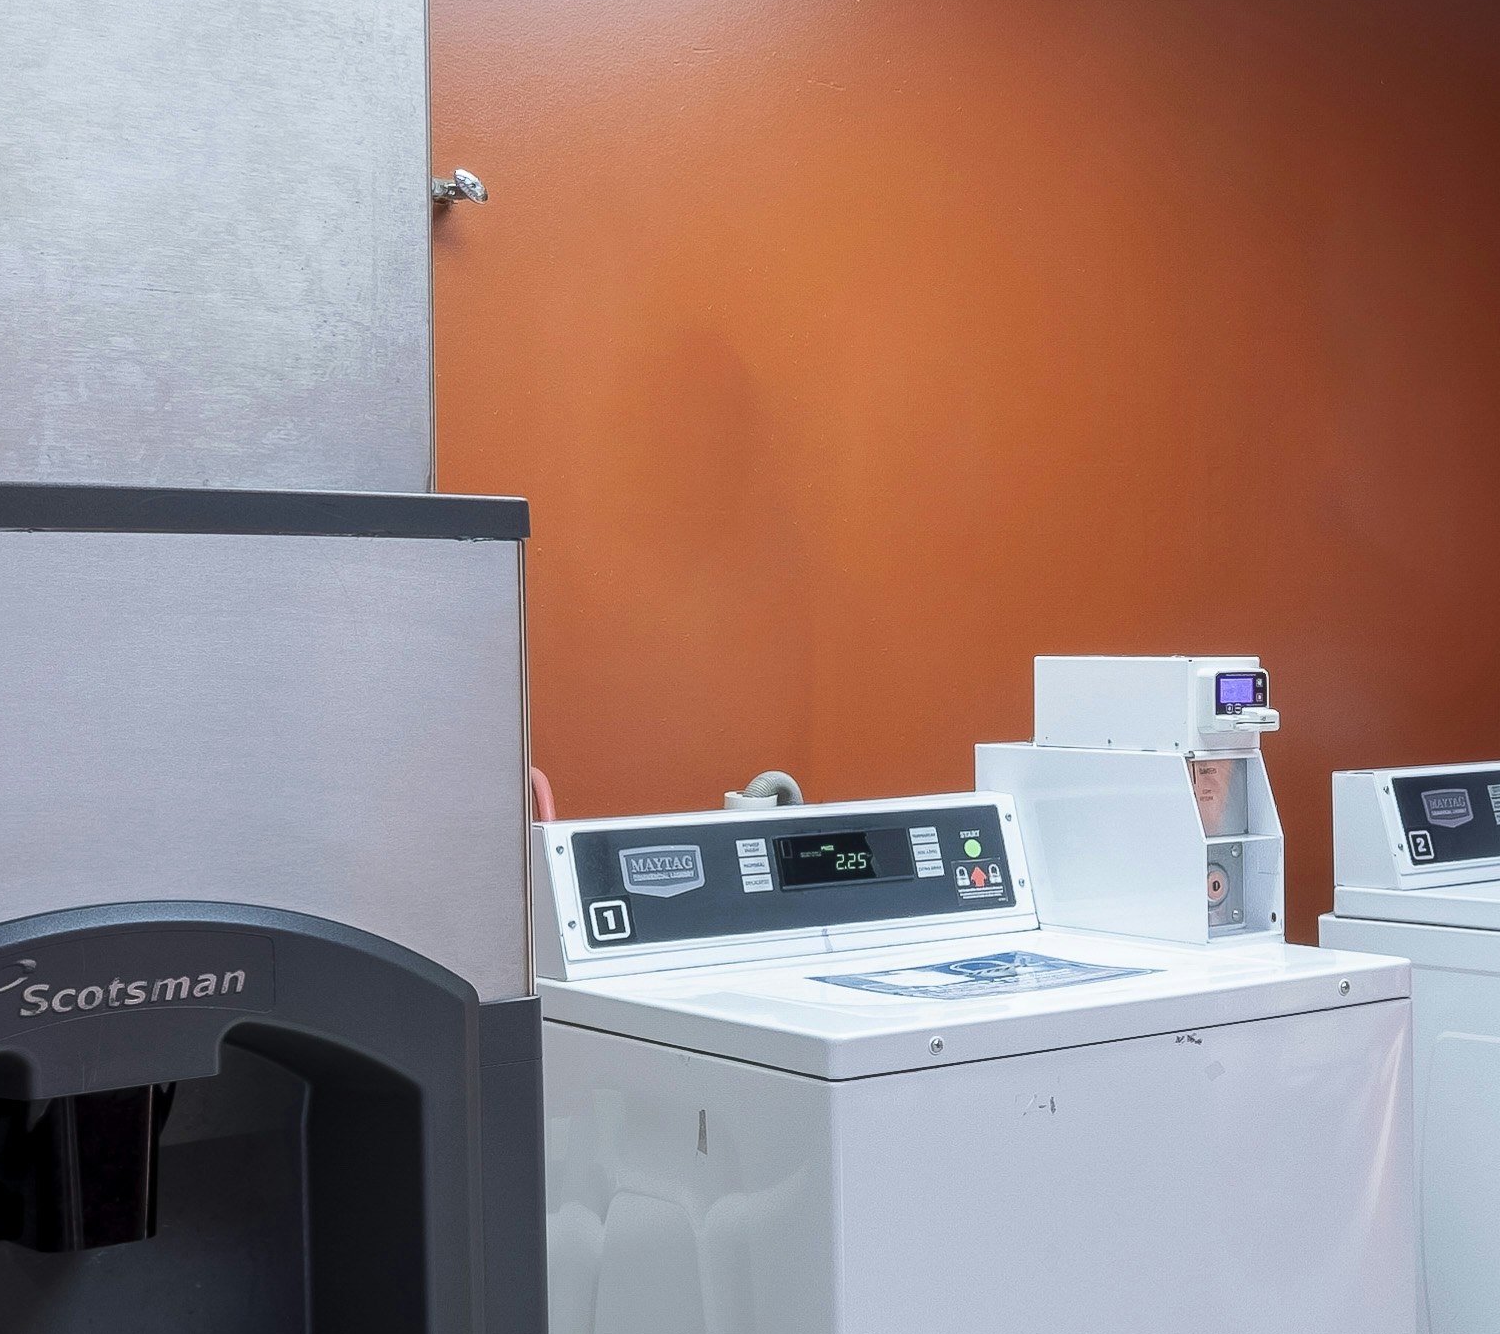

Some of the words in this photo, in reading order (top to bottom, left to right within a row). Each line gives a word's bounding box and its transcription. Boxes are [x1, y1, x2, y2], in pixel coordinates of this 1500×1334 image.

[1428, 796, 1466, 809] MAYTAG
[960, 830, 980, 838] START
[1416, 837, 1427, 853] 2
[630, 855, 693, 873] MAYTAG
[836, 852, 867, 870] 2.25
[602, 909, 616, 930] 1
[19, 968, 246, 1017] Scotsman
